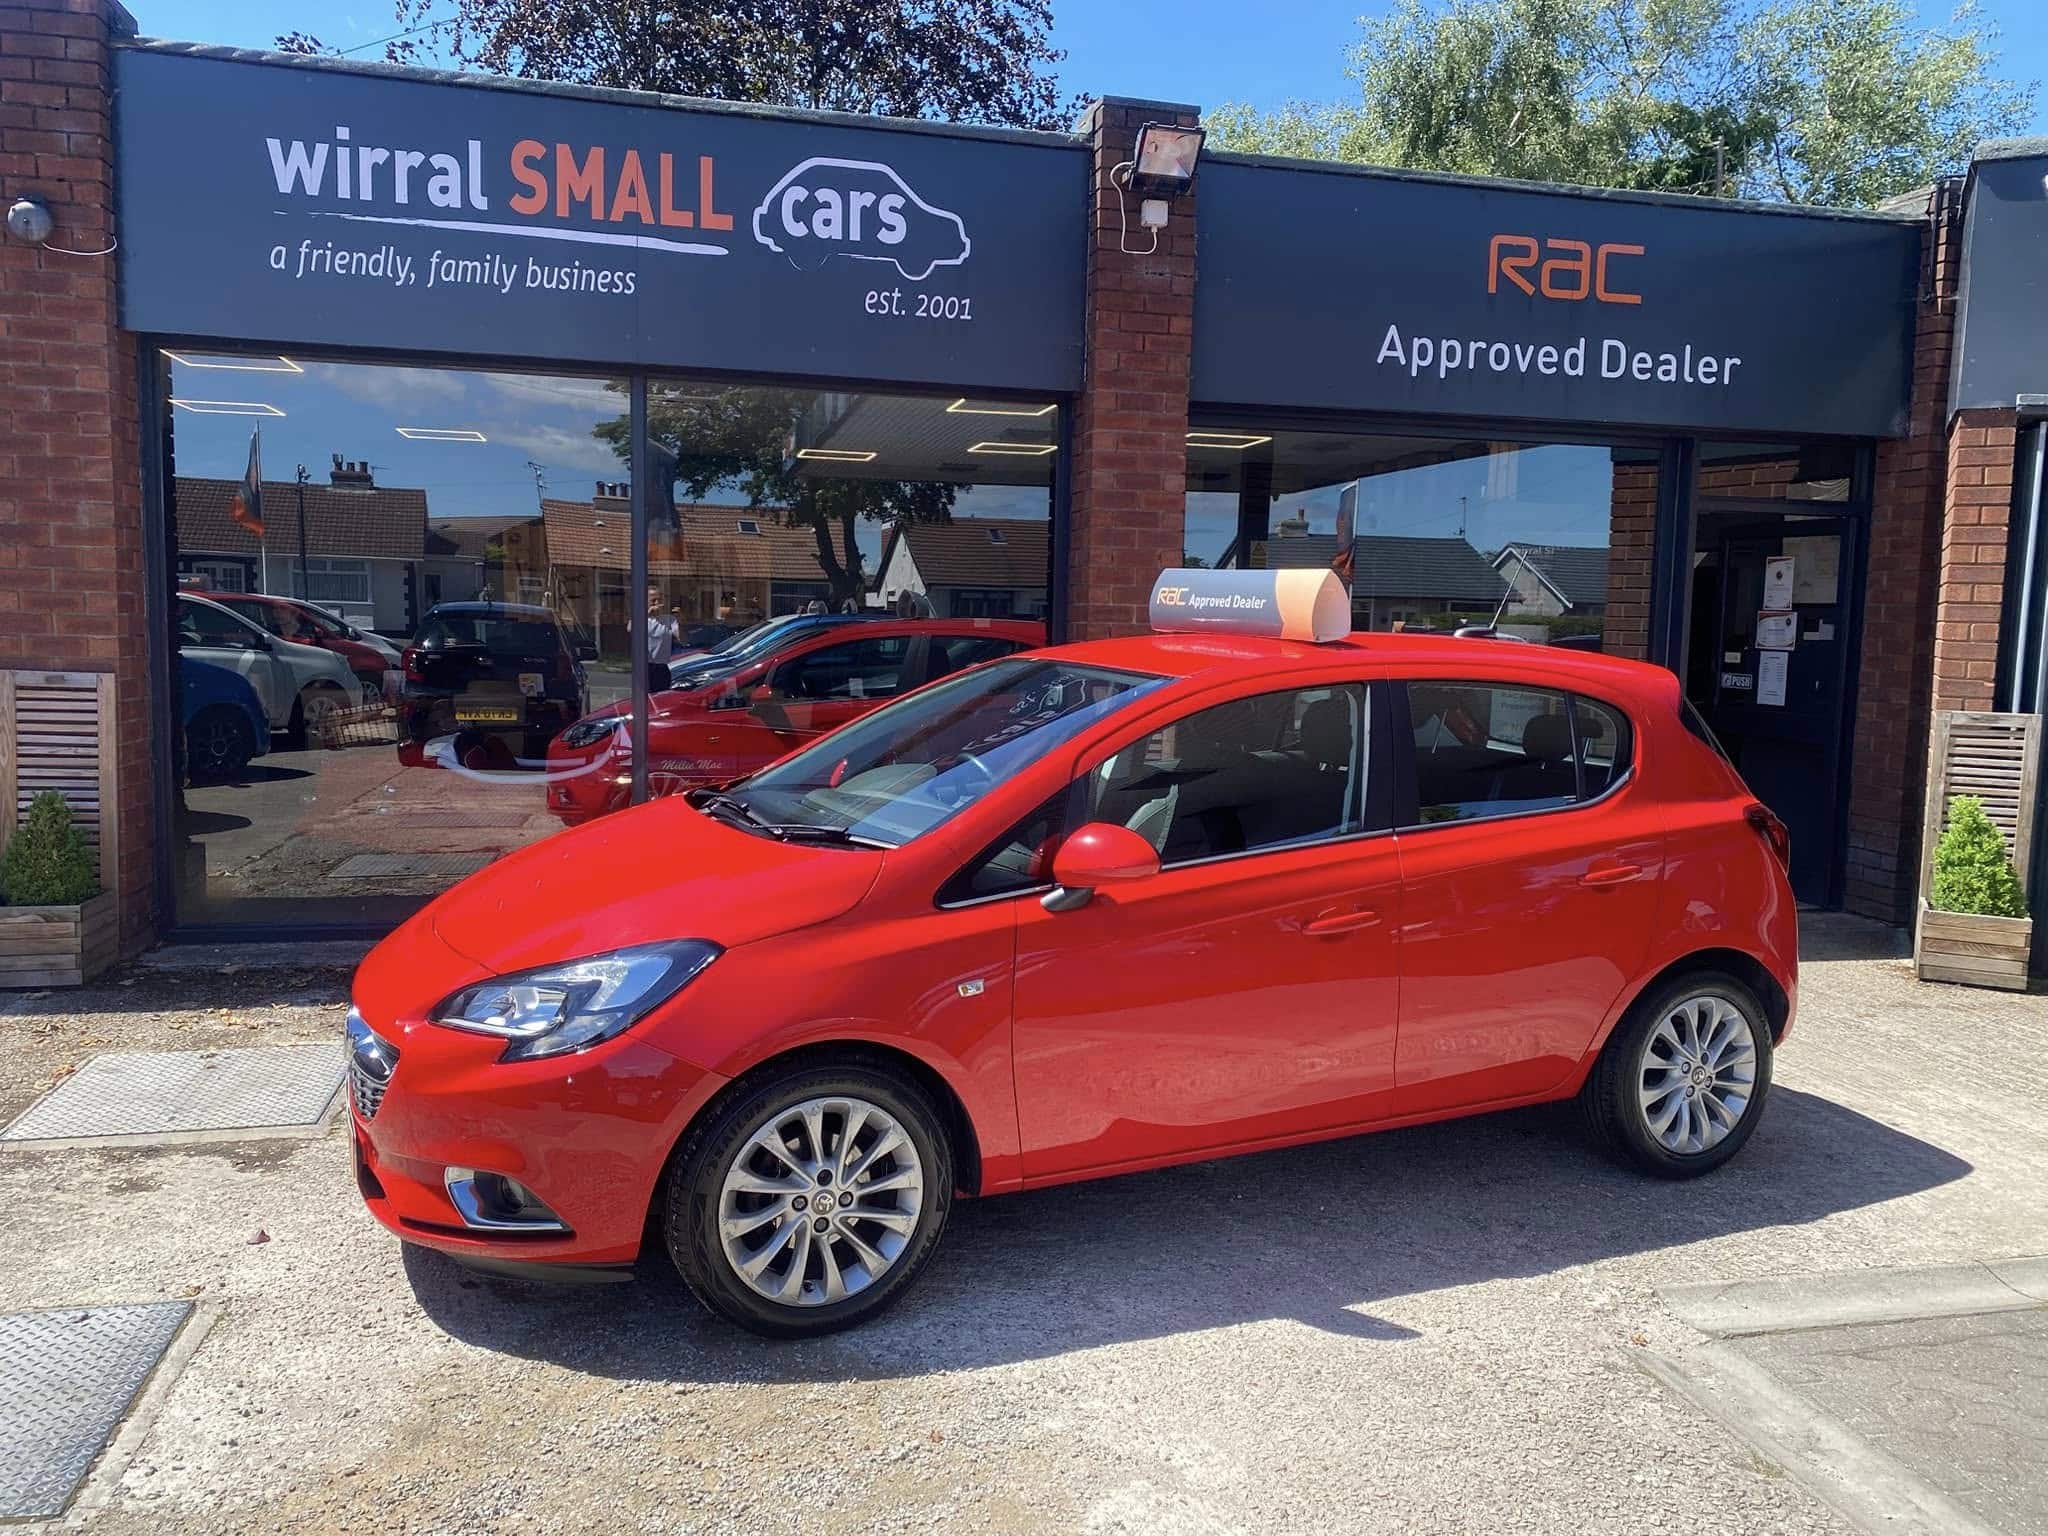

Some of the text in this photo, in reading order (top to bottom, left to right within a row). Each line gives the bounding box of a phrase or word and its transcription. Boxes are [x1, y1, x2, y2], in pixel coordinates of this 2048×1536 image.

[266, 126, 907, 244] wirral SMALL cars
[270, 240, 637, 295] a friendly, family business
[865, 287, 973, 321] est. 2001
[1376, 324, 1742, 385] Approved Dealer
[1188, 593, 1231, 610] Approved
[1232, 594, 1267, 609] Dealer
